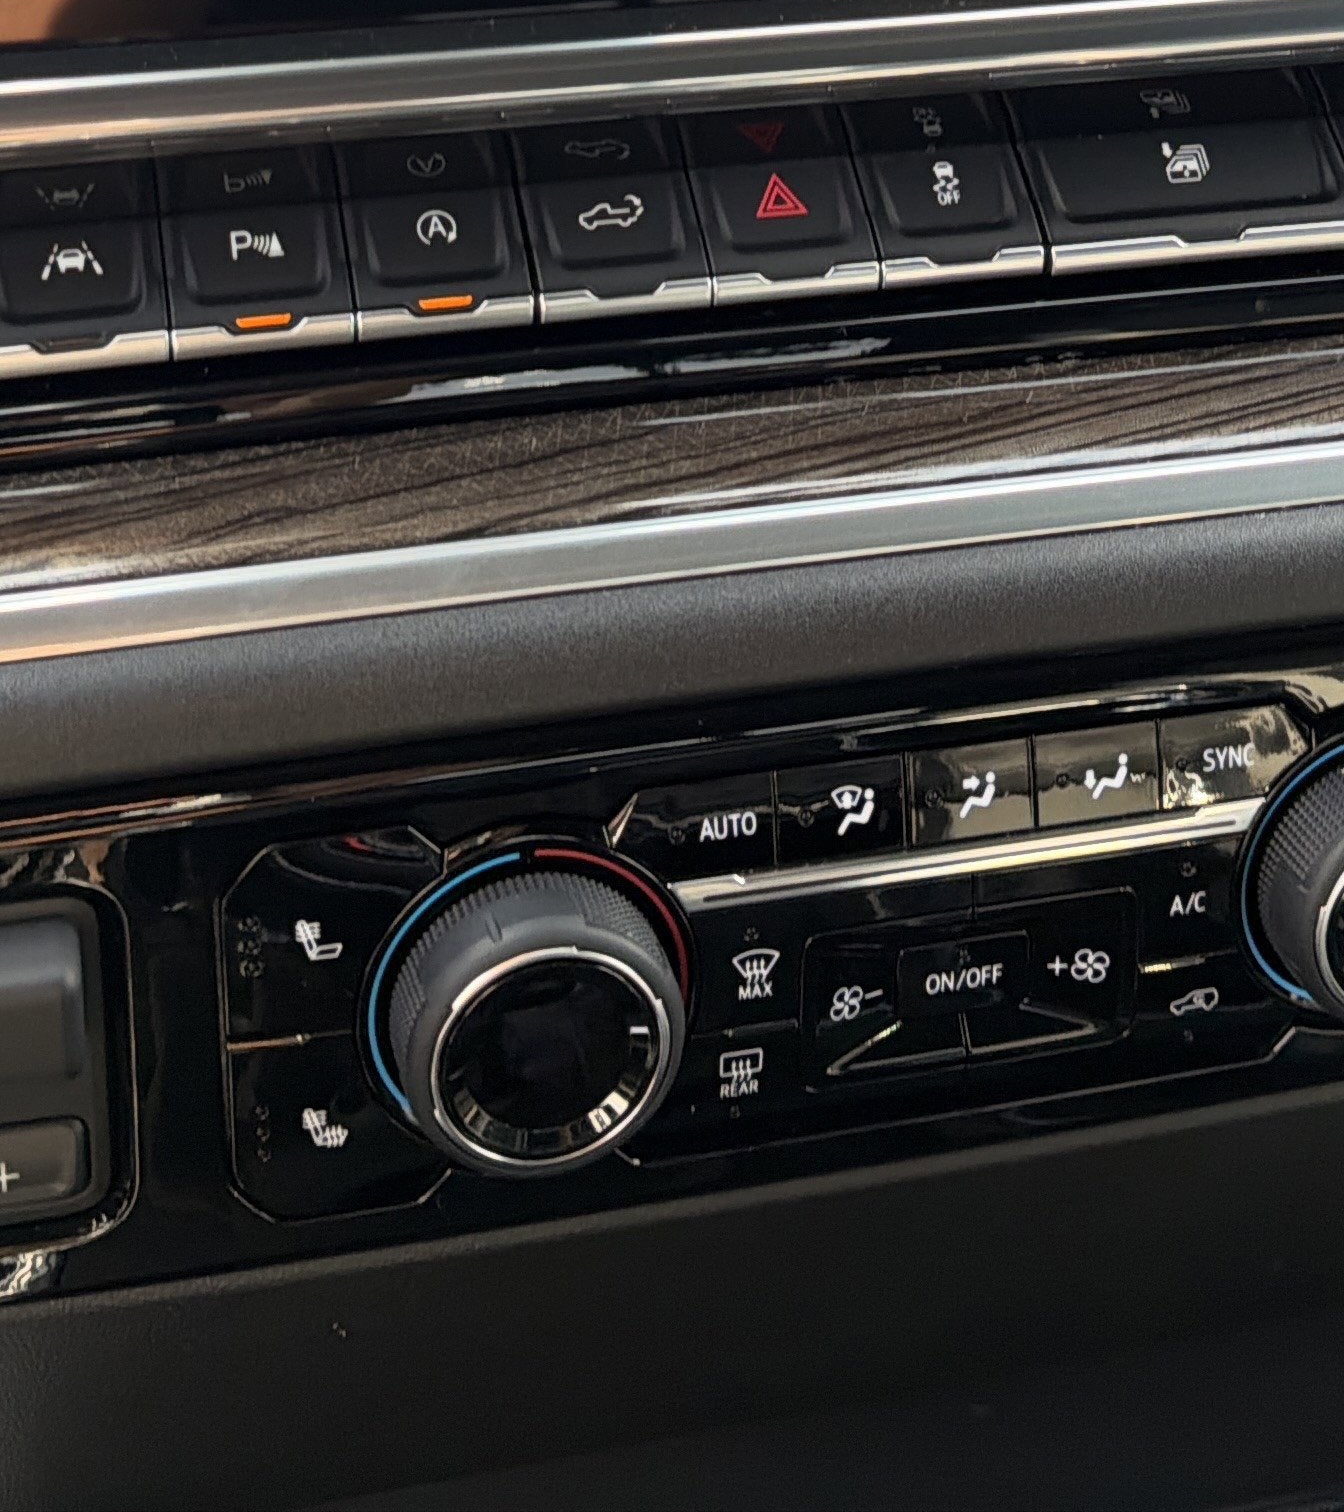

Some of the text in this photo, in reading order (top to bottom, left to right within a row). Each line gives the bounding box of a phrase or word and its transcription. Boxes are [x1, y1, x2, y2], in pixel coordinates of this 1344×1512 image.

[937, 189, 960, 206] OFF
[229, 229, 253, 261] P
[1202, 742, 1256, 773] SYNC
[699, 811, 757, 843] AUTO
[1170, 890, 1207, 918] A/C
[738, 979, 774, 1001] MAX
[925, 962, 1003, 996] ON/OFF
[719, 1078, 759, 1100] REAR
